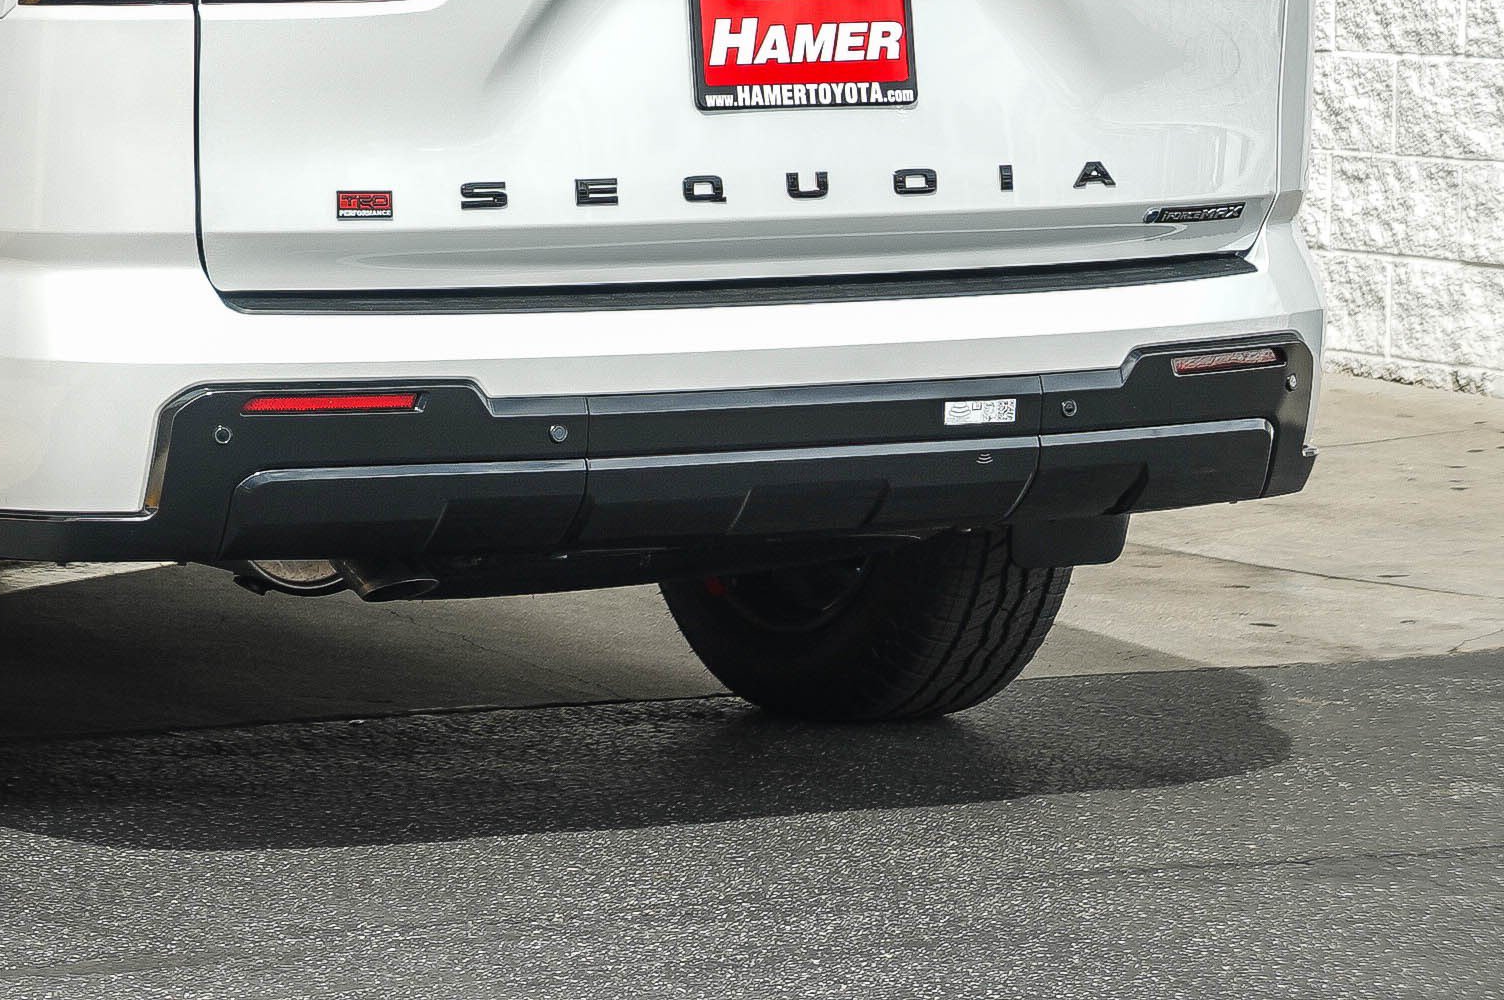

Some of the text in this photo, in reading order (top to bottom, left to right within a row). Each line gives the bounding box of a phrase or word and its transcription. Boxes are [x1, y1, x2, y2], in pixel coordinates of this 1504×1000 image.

[708, 17, 903, 66] HAMER
[706, 82, 914, 107] www.HAMERTOYOTA.com
[460, 160, 1117, 210] SEQUOIA
[338, 209, 392, 217] PERFORMANCE
[340, 194, 389, 210] TRD
